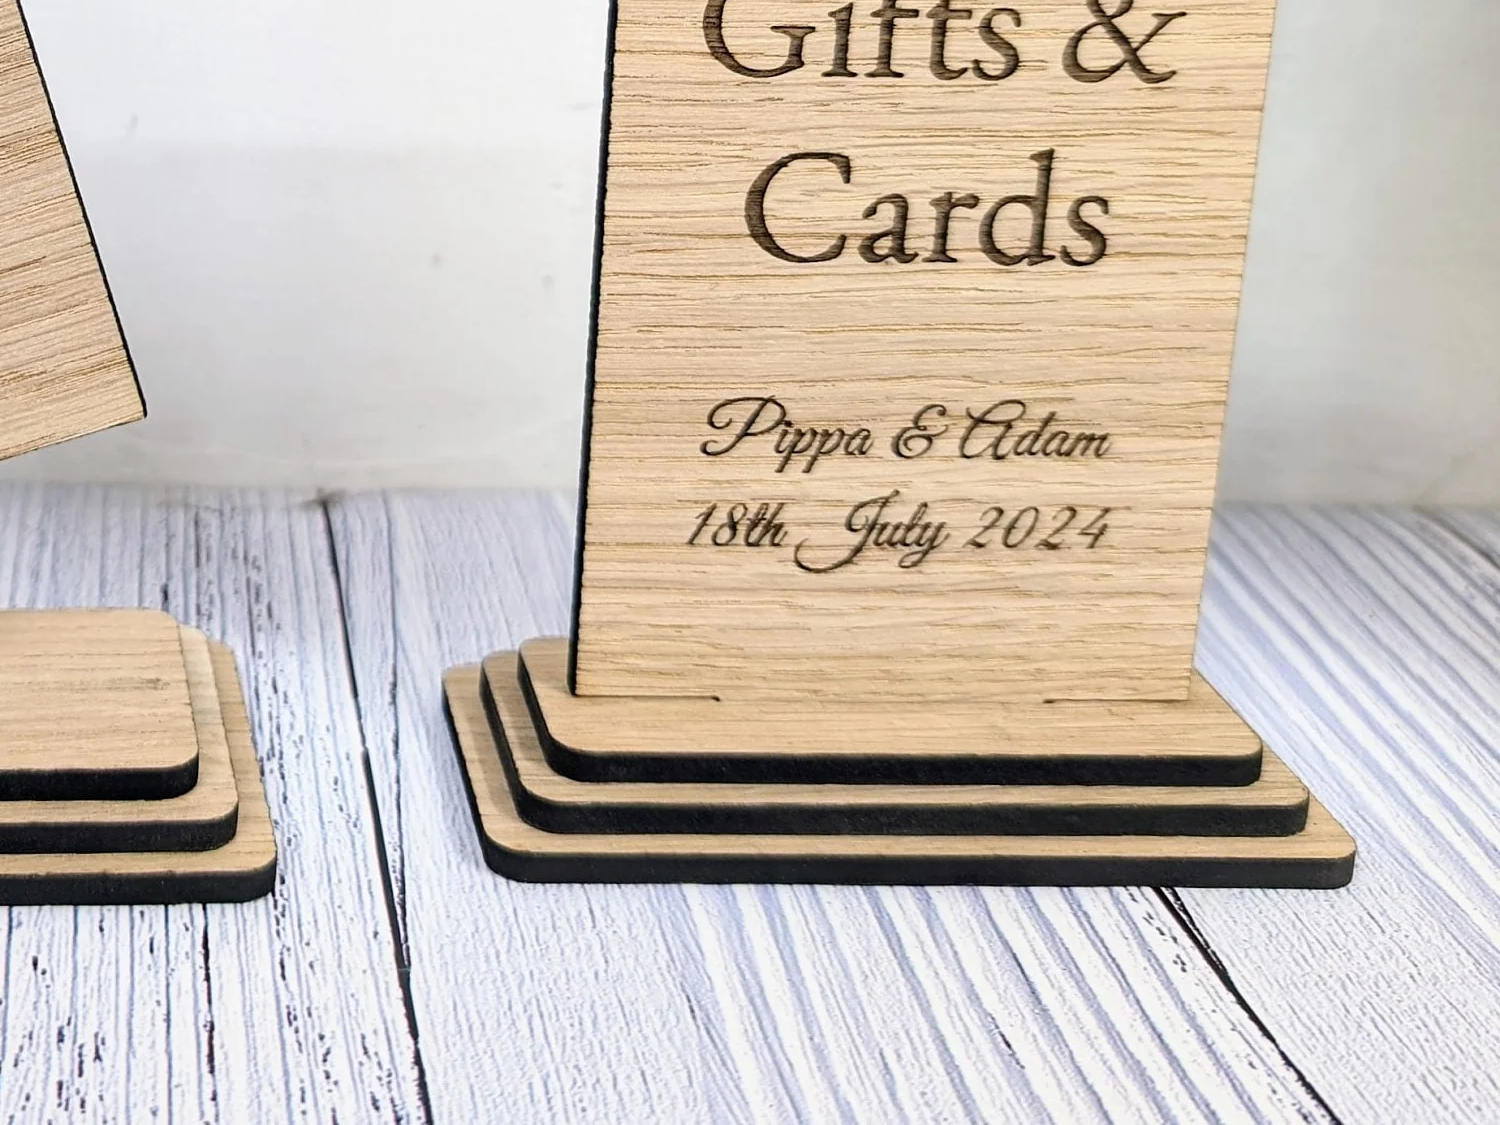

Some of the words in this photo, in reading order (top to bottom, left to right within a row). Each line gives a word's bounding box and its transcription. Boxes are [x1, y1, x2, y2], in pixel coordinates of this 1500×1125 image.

[743, 147, 1113, 267] Cards
[699, 394, 873, 474] Pippa
[889, 403, 949, 460] &
[958, 399, 1112, 461] Adam
[687, 501, 788, 548] 18th
[792, 489, 949, 574] July
[965, 505, 1113, 551] 2024
